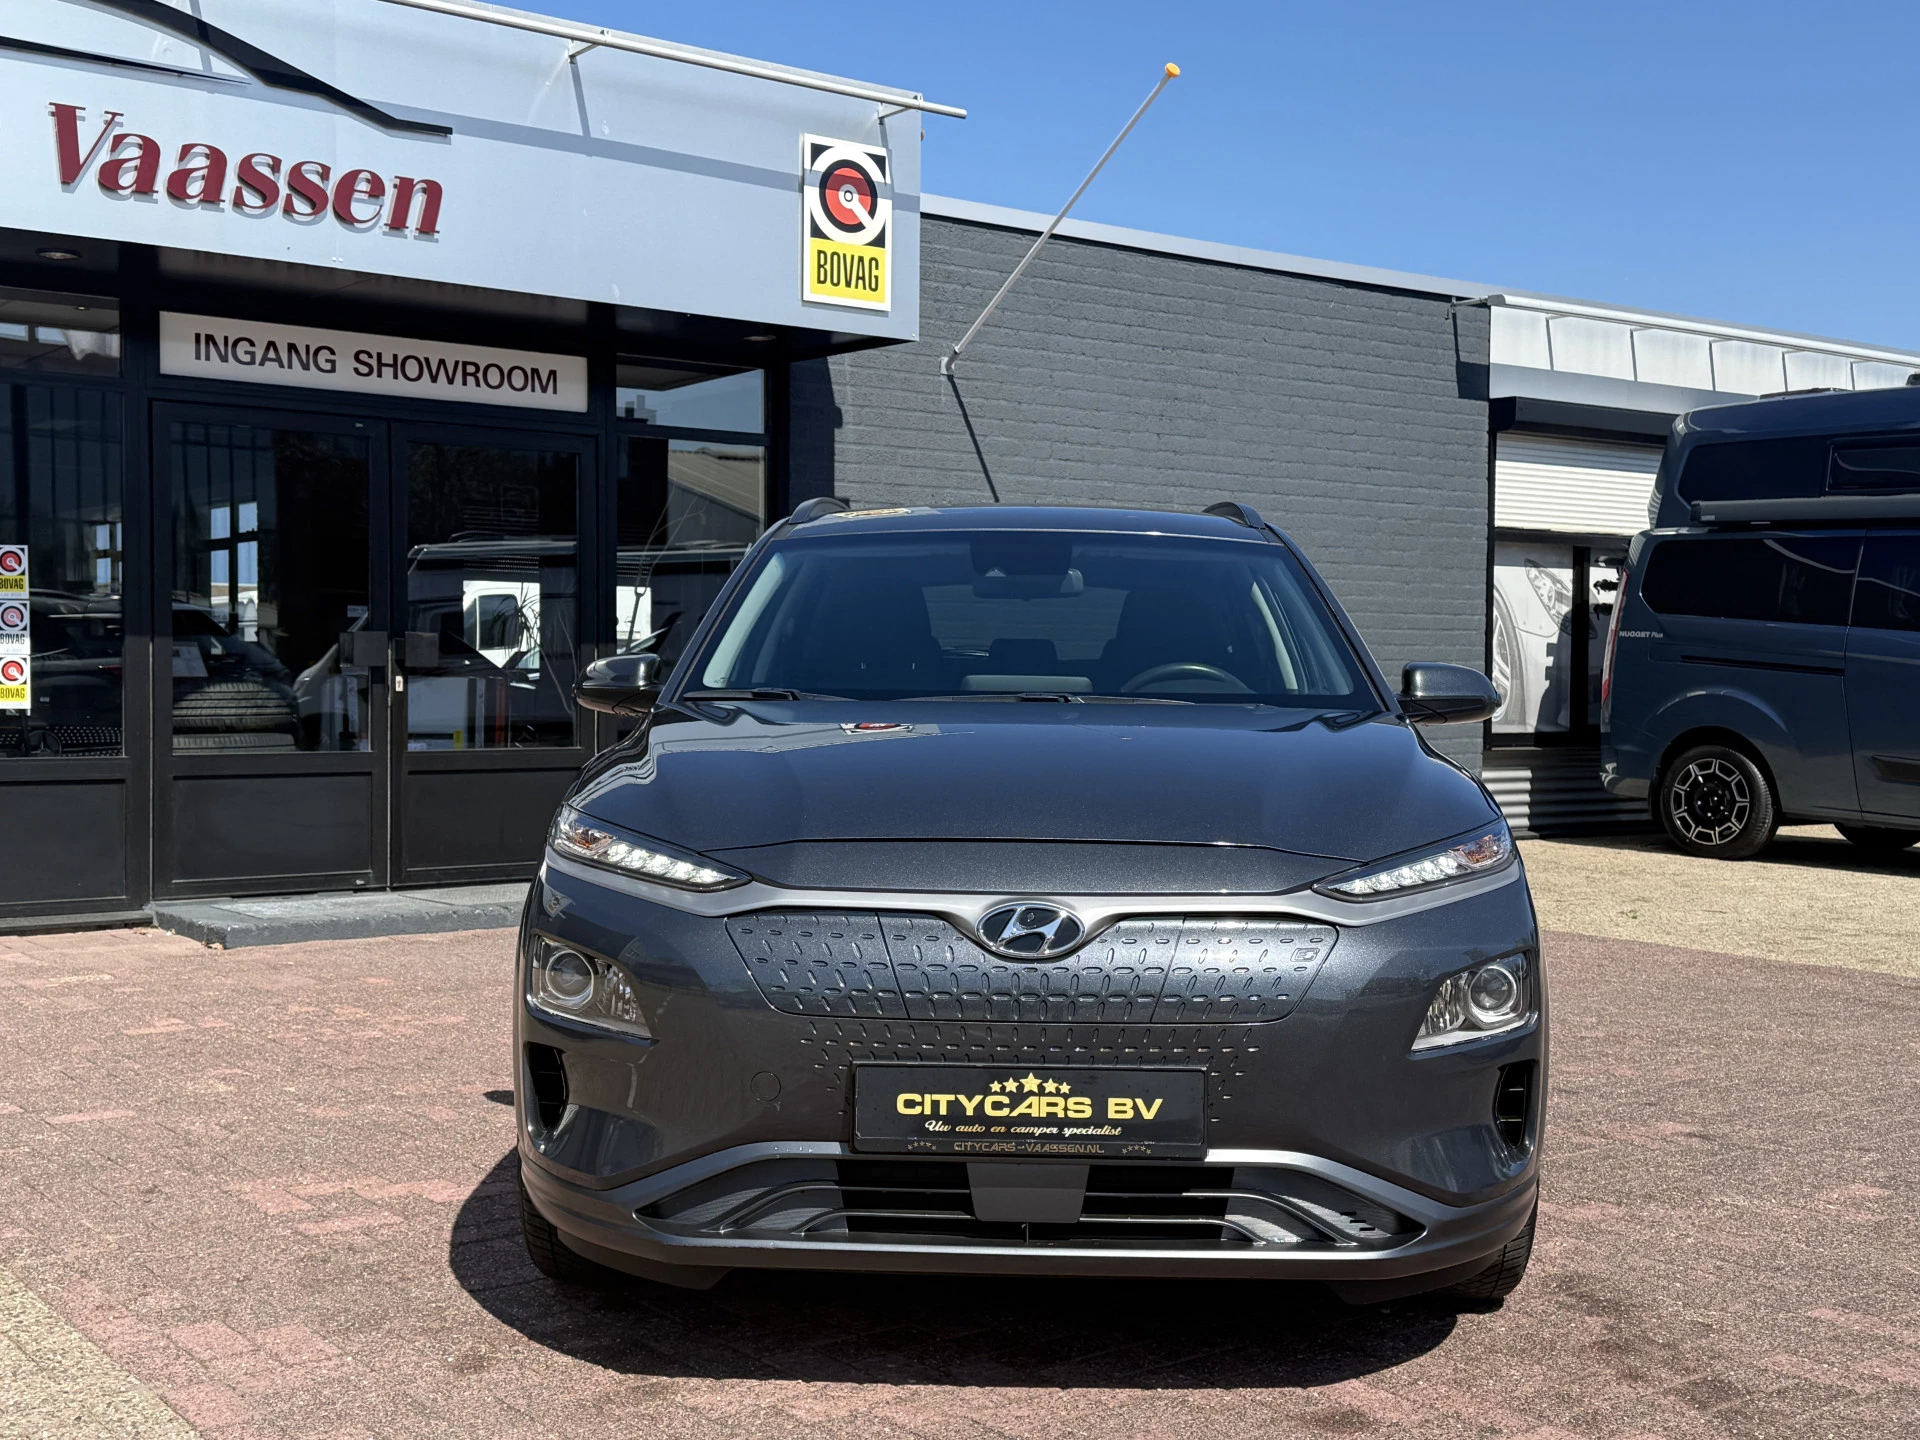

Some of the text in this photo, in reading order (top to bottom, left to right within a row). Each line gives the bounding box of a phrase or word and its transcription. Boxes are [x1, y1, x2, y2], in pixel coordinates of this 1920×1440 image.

[48, 102, 444, 234] Vaassen
[816, 249, 880, 293] BOVAG
[193, 332, 559, 395] INGANG SHOWROOM
[0, 633, 25, 645] BOVAG
[1619, 630, 1651, 638] NUGGET
[0, 687, 25, 699] BOVAG
[896, 1093, 1164, 1120] CITYCARS BV
[924, 1119, 1123, 1138] Uw auto en camper specialist
[953, 1141, 1105, 1154] CITYCARS-VAASSEN.NL
